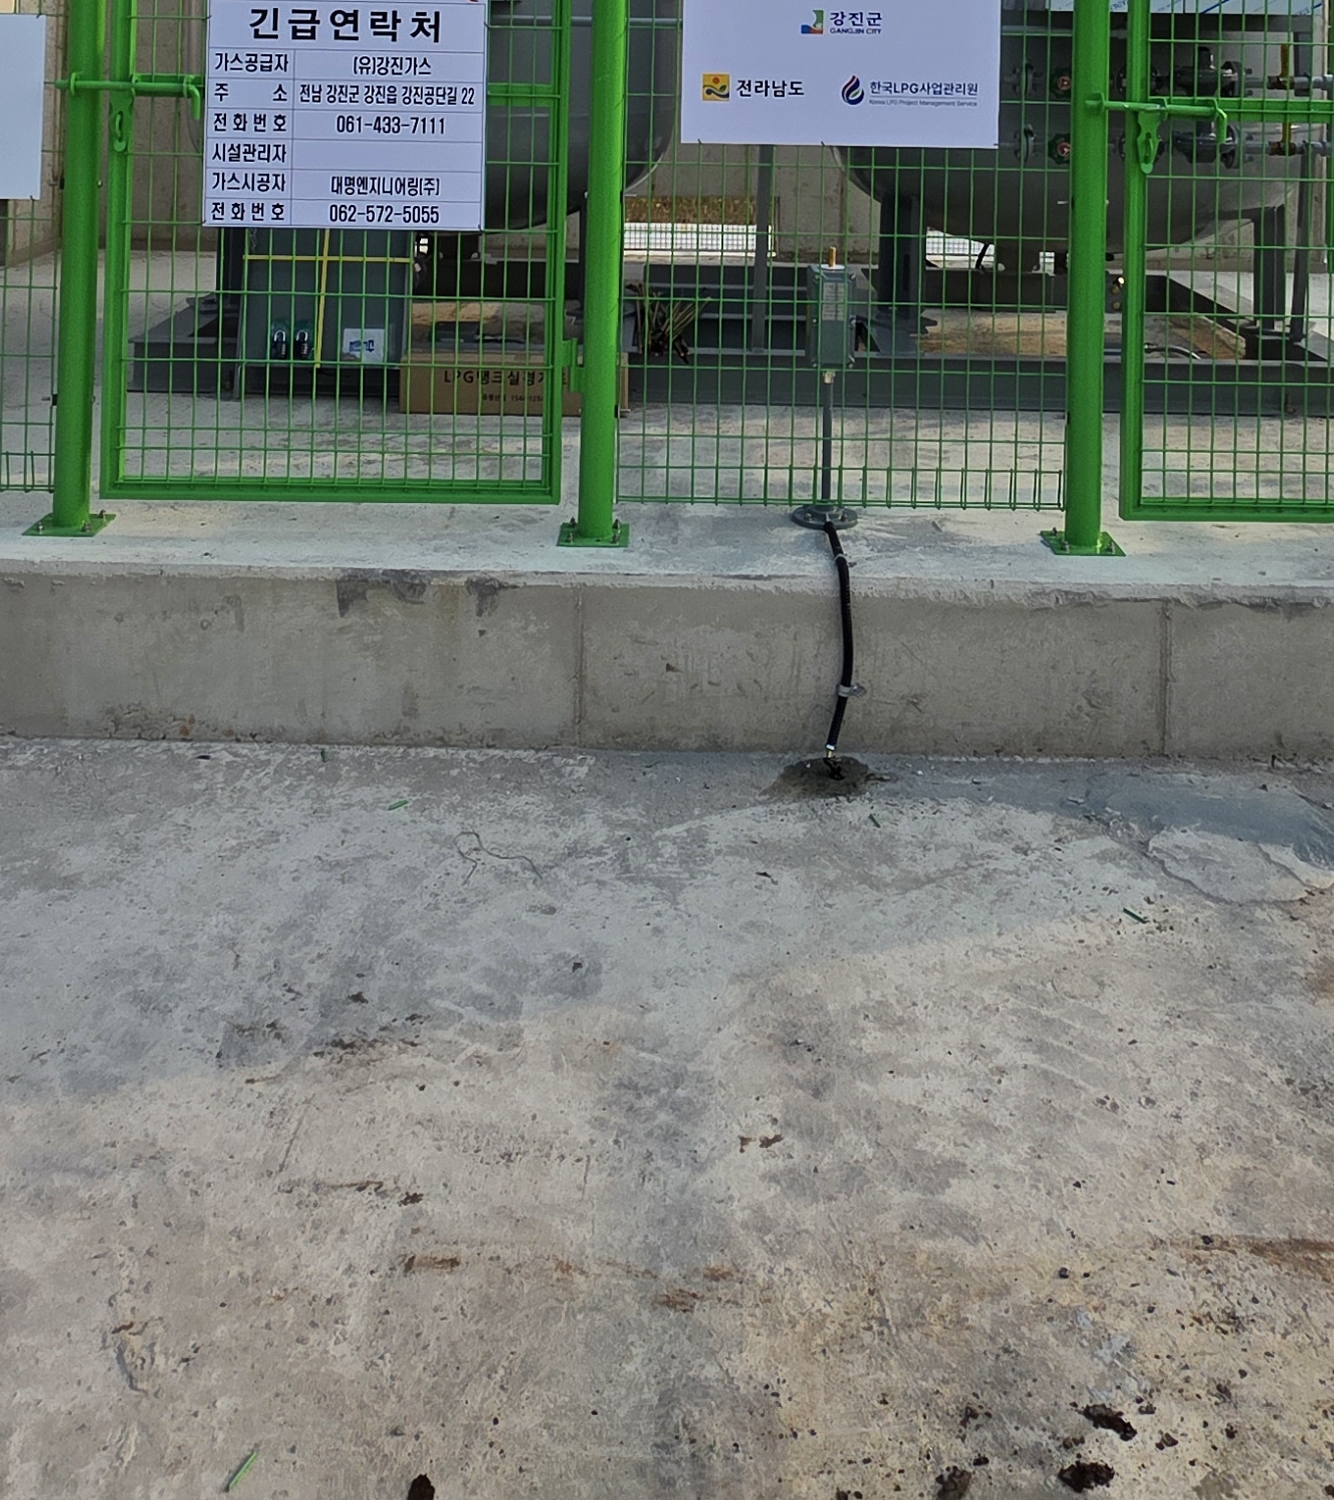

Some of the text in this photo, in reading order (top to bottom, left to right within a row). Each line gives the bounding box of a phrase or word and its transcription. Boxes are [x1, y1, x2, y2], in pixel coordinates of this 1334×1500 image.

[830, 12, 882, 26] 강진군
[215, 53, 431, 75] 가스공급자 (유)강진가스
[300, 84, 322, 102] 전남
[327, 85, 359, 103] 강진군
[364, 85, 397, 104] 강진읍
[402, 86, 457, 105] 강진공단길
[462, 88, 474, 104] 22
[737, 80, 804, 97] 전라남도
[870, 82, 977, 95] 한국LPG사업관리원
[337, 115, 444, 134] 061-433-7111
[212, 143, 286, 163] 시설관리자
[213, 172, 439, 196] 가스시공자 대명엔지니어링(주)
[330, 205, 439, 223] 062-572-5055
